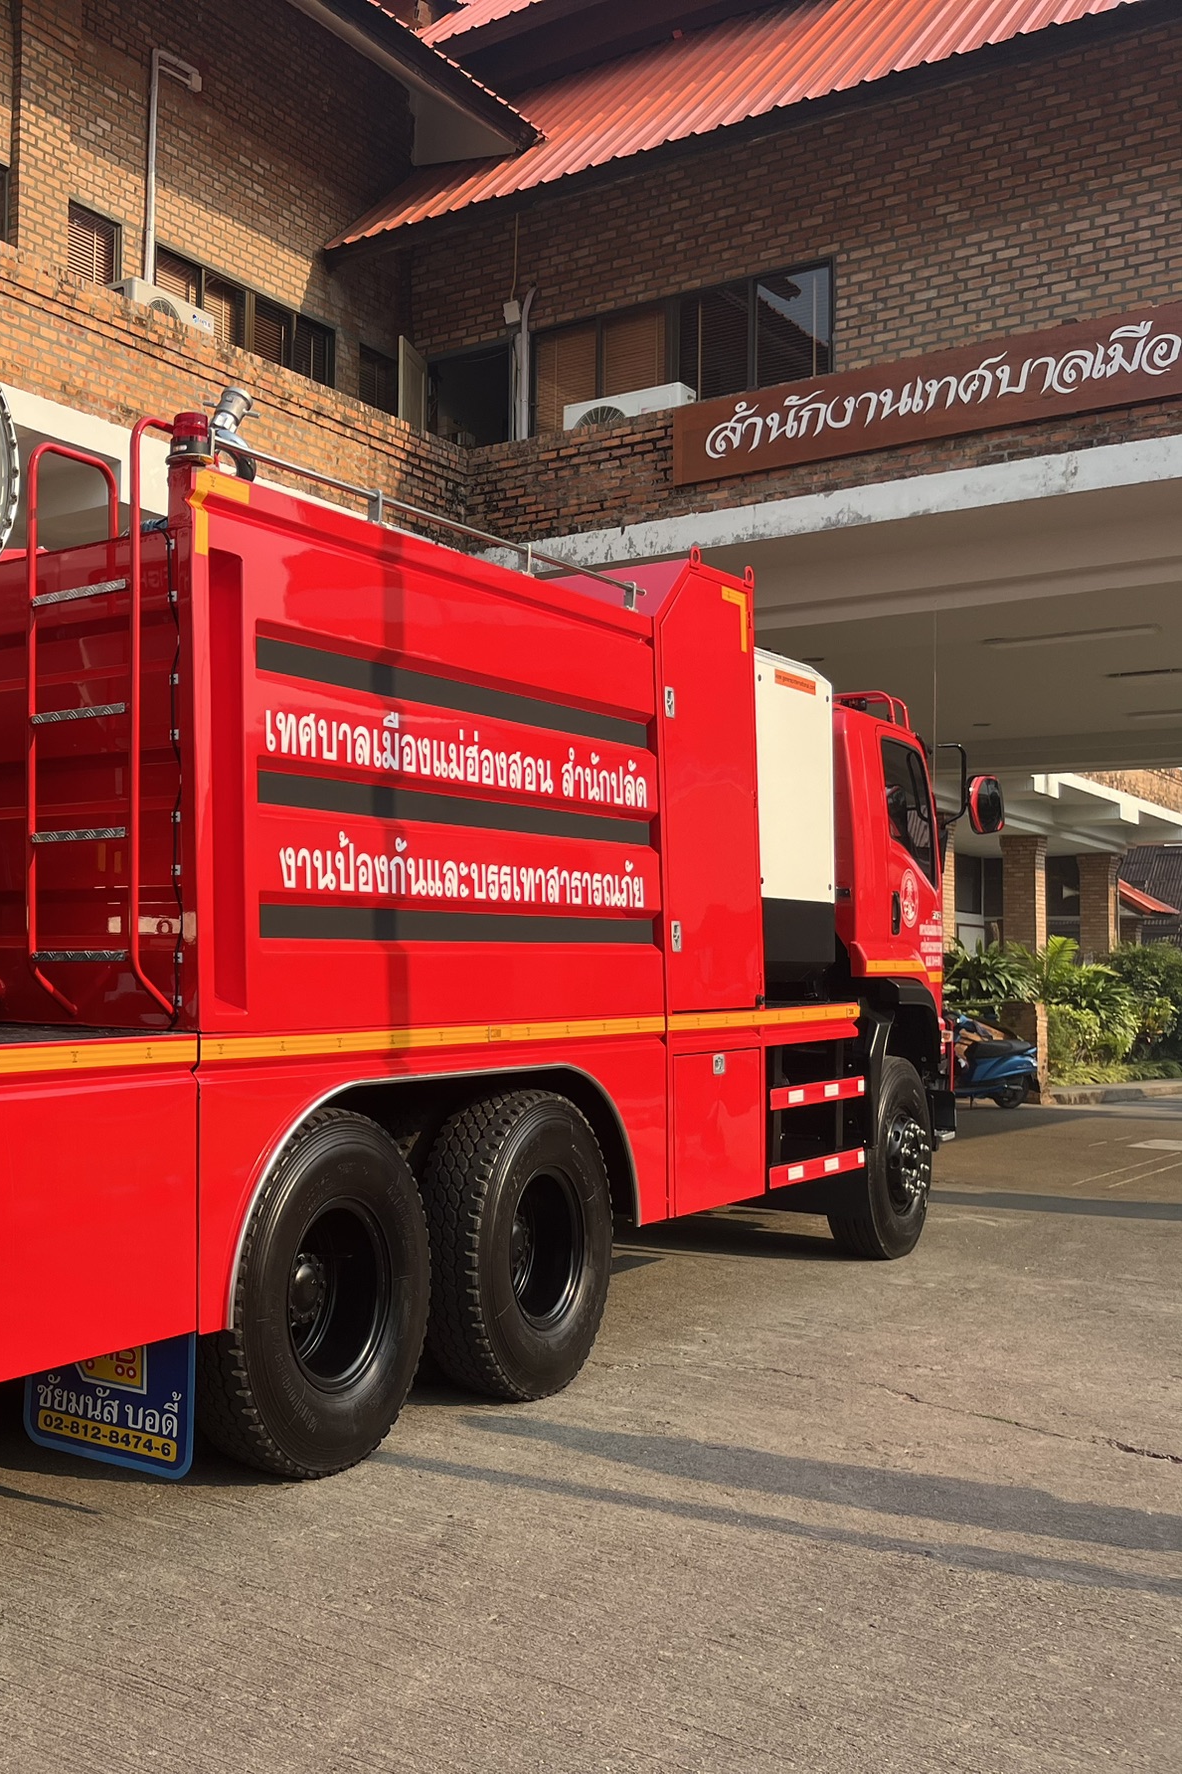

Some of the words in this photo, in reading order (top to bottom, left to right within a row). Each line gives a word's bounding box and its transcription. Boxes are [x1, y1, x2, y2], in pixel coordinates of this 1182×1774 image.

[704, 319, 1182, 460] สำนักงานเทศบาลเมือ
[264, 708, 554, 795] เทศบาลเมืองแม่ฮ่องสอน
[560, 746, 648, 808] สำนักปลัด
[278, 830, 645, 908] งานป้องกันและบรรเทาสาธารณภัย
[37, 1373, 120, 1425] ชัยมนัส
[124, 1391, 182, 1439] บอดี้
[43, 1413, 171, 1457] 02-812-8474-6
